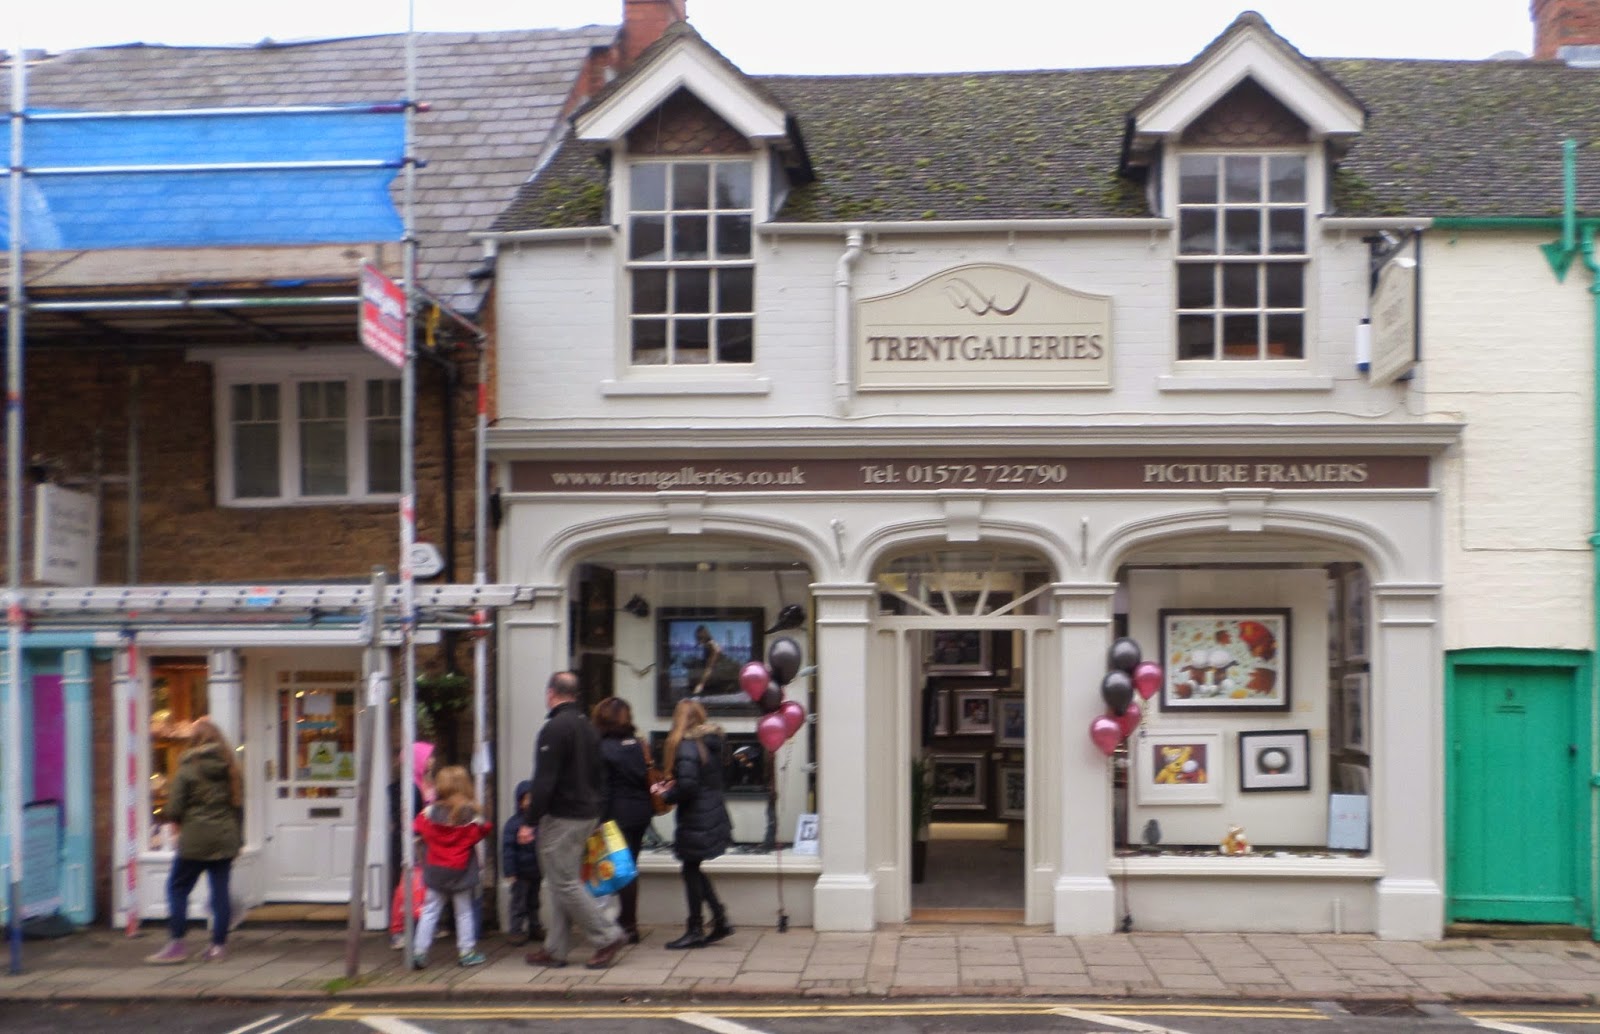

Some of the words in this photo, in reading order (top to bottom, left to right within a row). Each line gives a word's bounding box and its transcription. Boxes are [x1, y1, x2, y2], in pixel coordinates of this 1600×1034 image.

[552, 466, 805, 489] www.trentgalleries.co.uk
[906, 465, 977, 483] 01572
[982, 465, 1067, 484] 722790
[1143, 464, 1249, 483] PICTURE
[1254, 463, 1368, 483] FRAMERS
